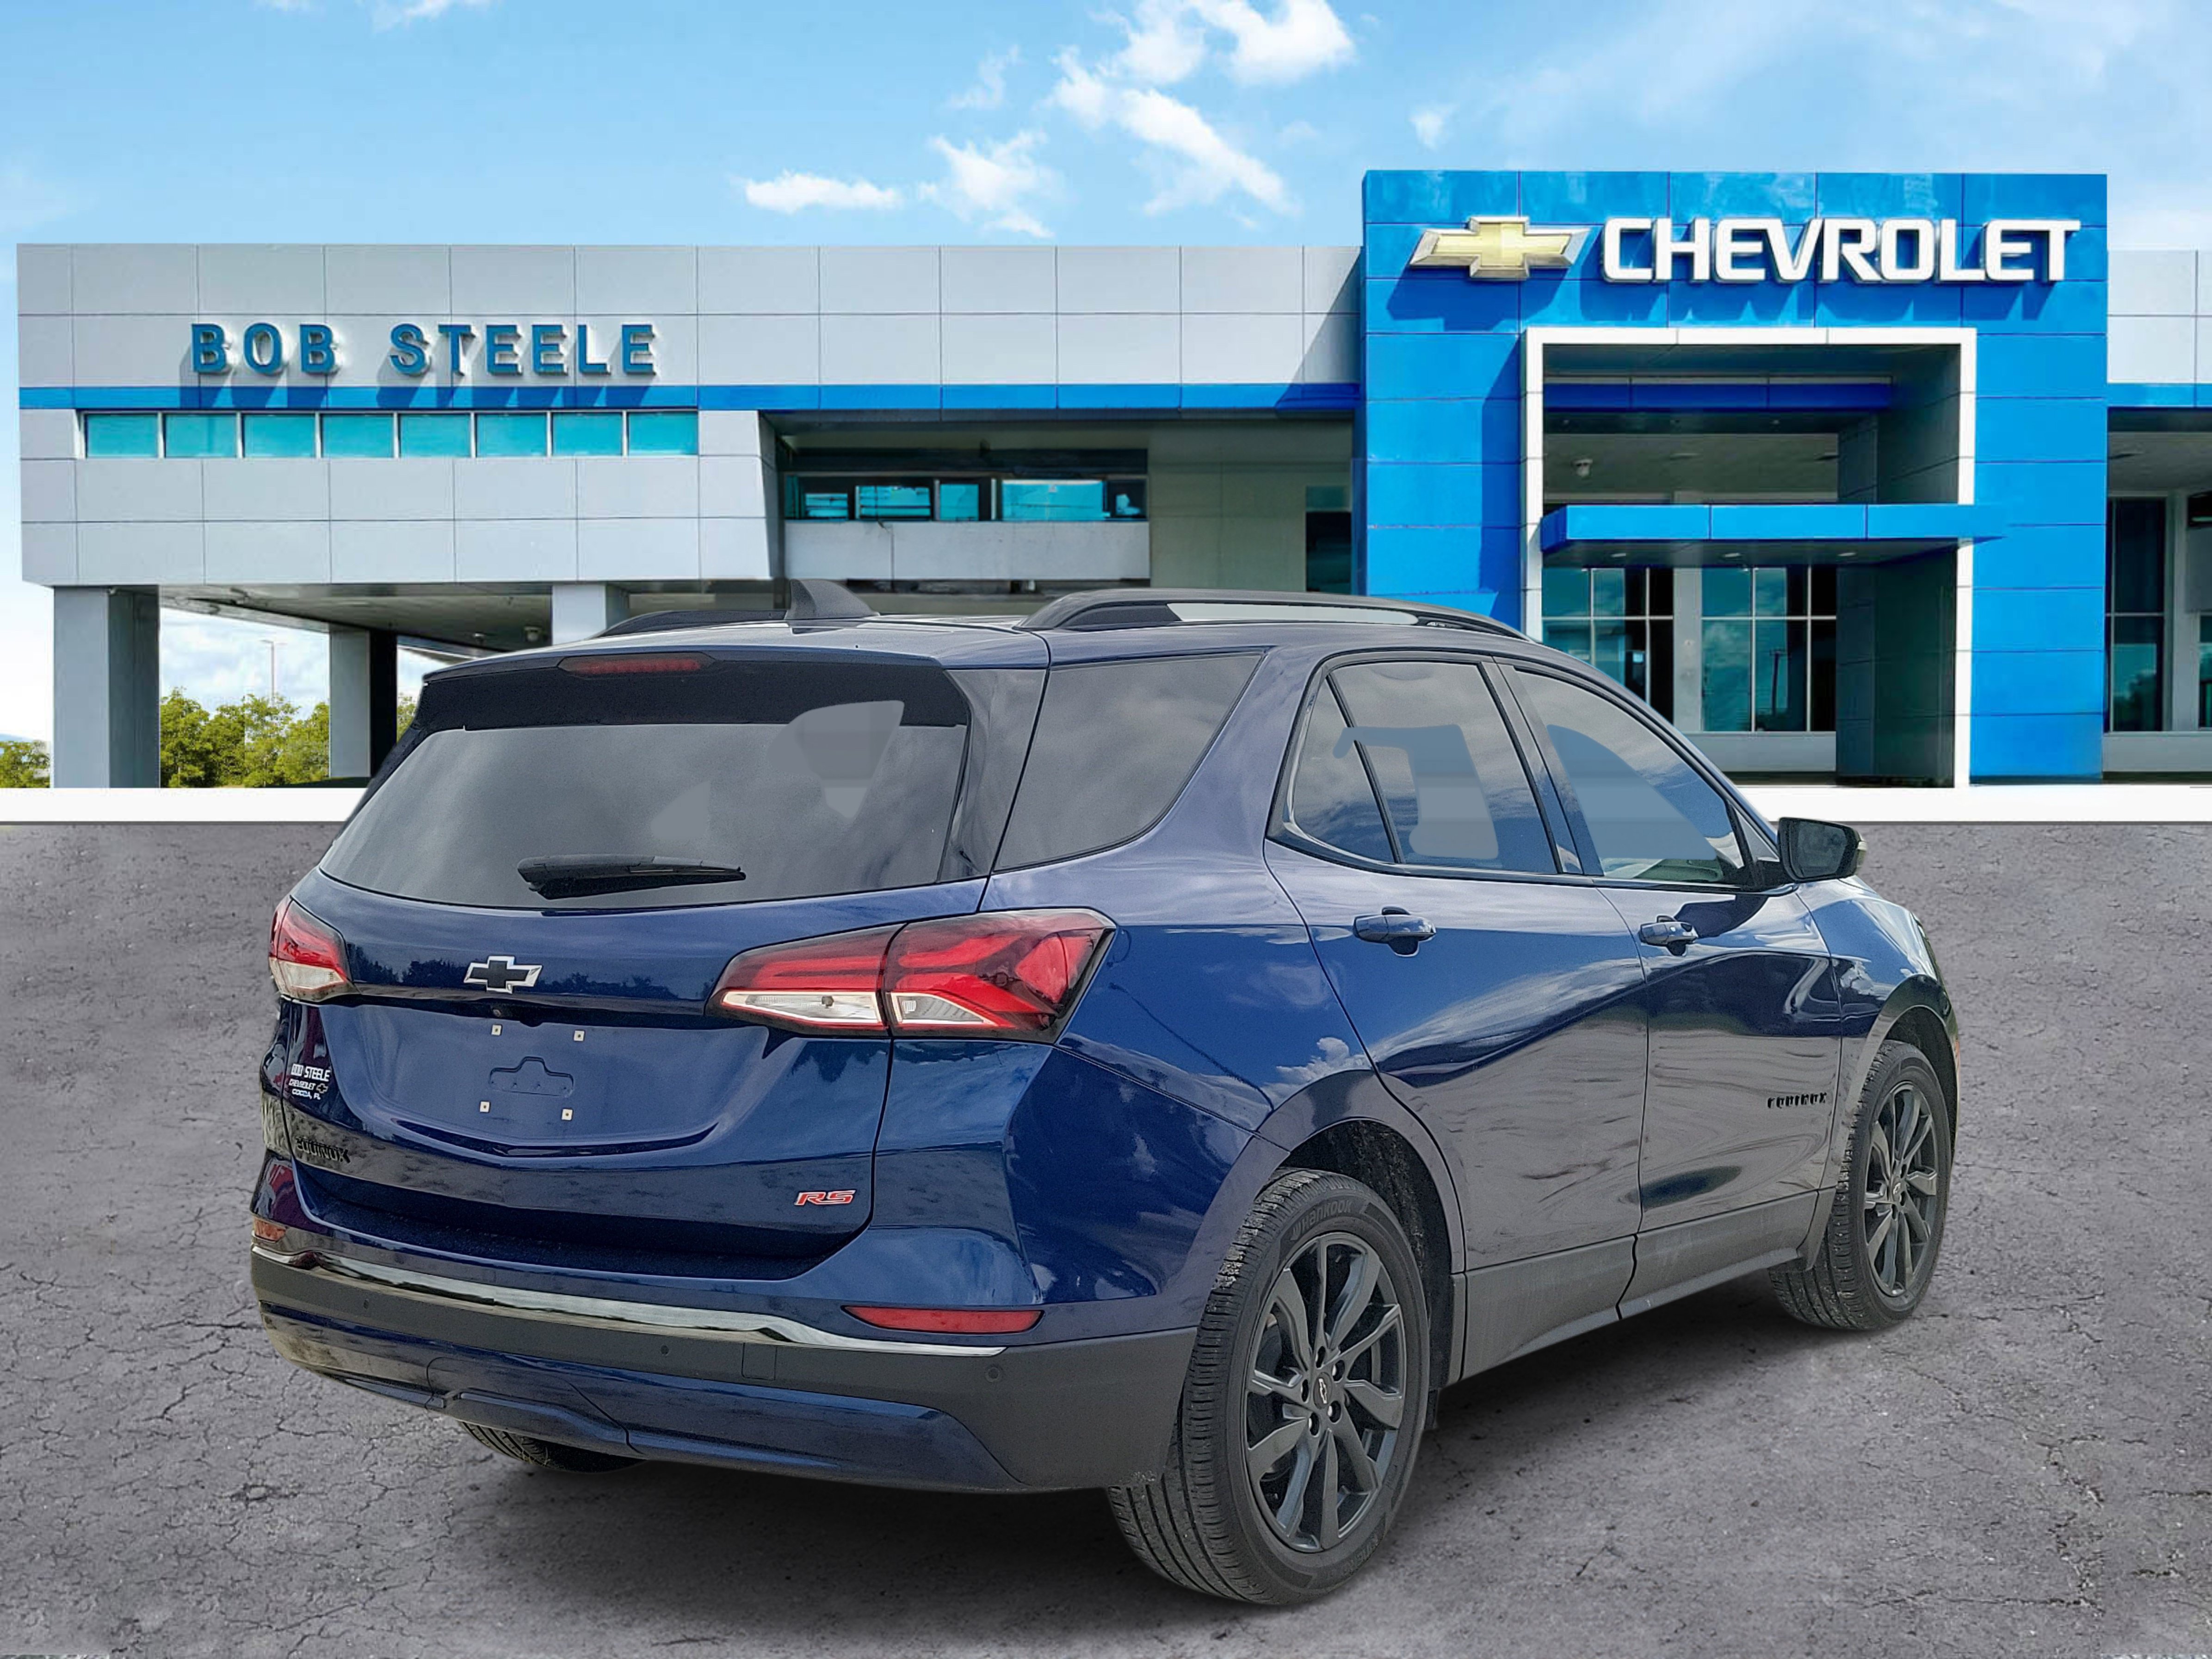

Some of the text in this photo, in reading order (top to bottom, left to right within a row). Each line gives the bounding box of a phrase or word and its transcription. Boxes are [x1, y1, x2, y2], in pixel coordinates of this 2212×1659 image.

[1601, 217, 2081, 283] CHEVROLET
[192, 323, 655, 376] BOB STEELE
[304, 1066, 331, 1082] STEELE
[794, 1189, 856, 1206] RS
